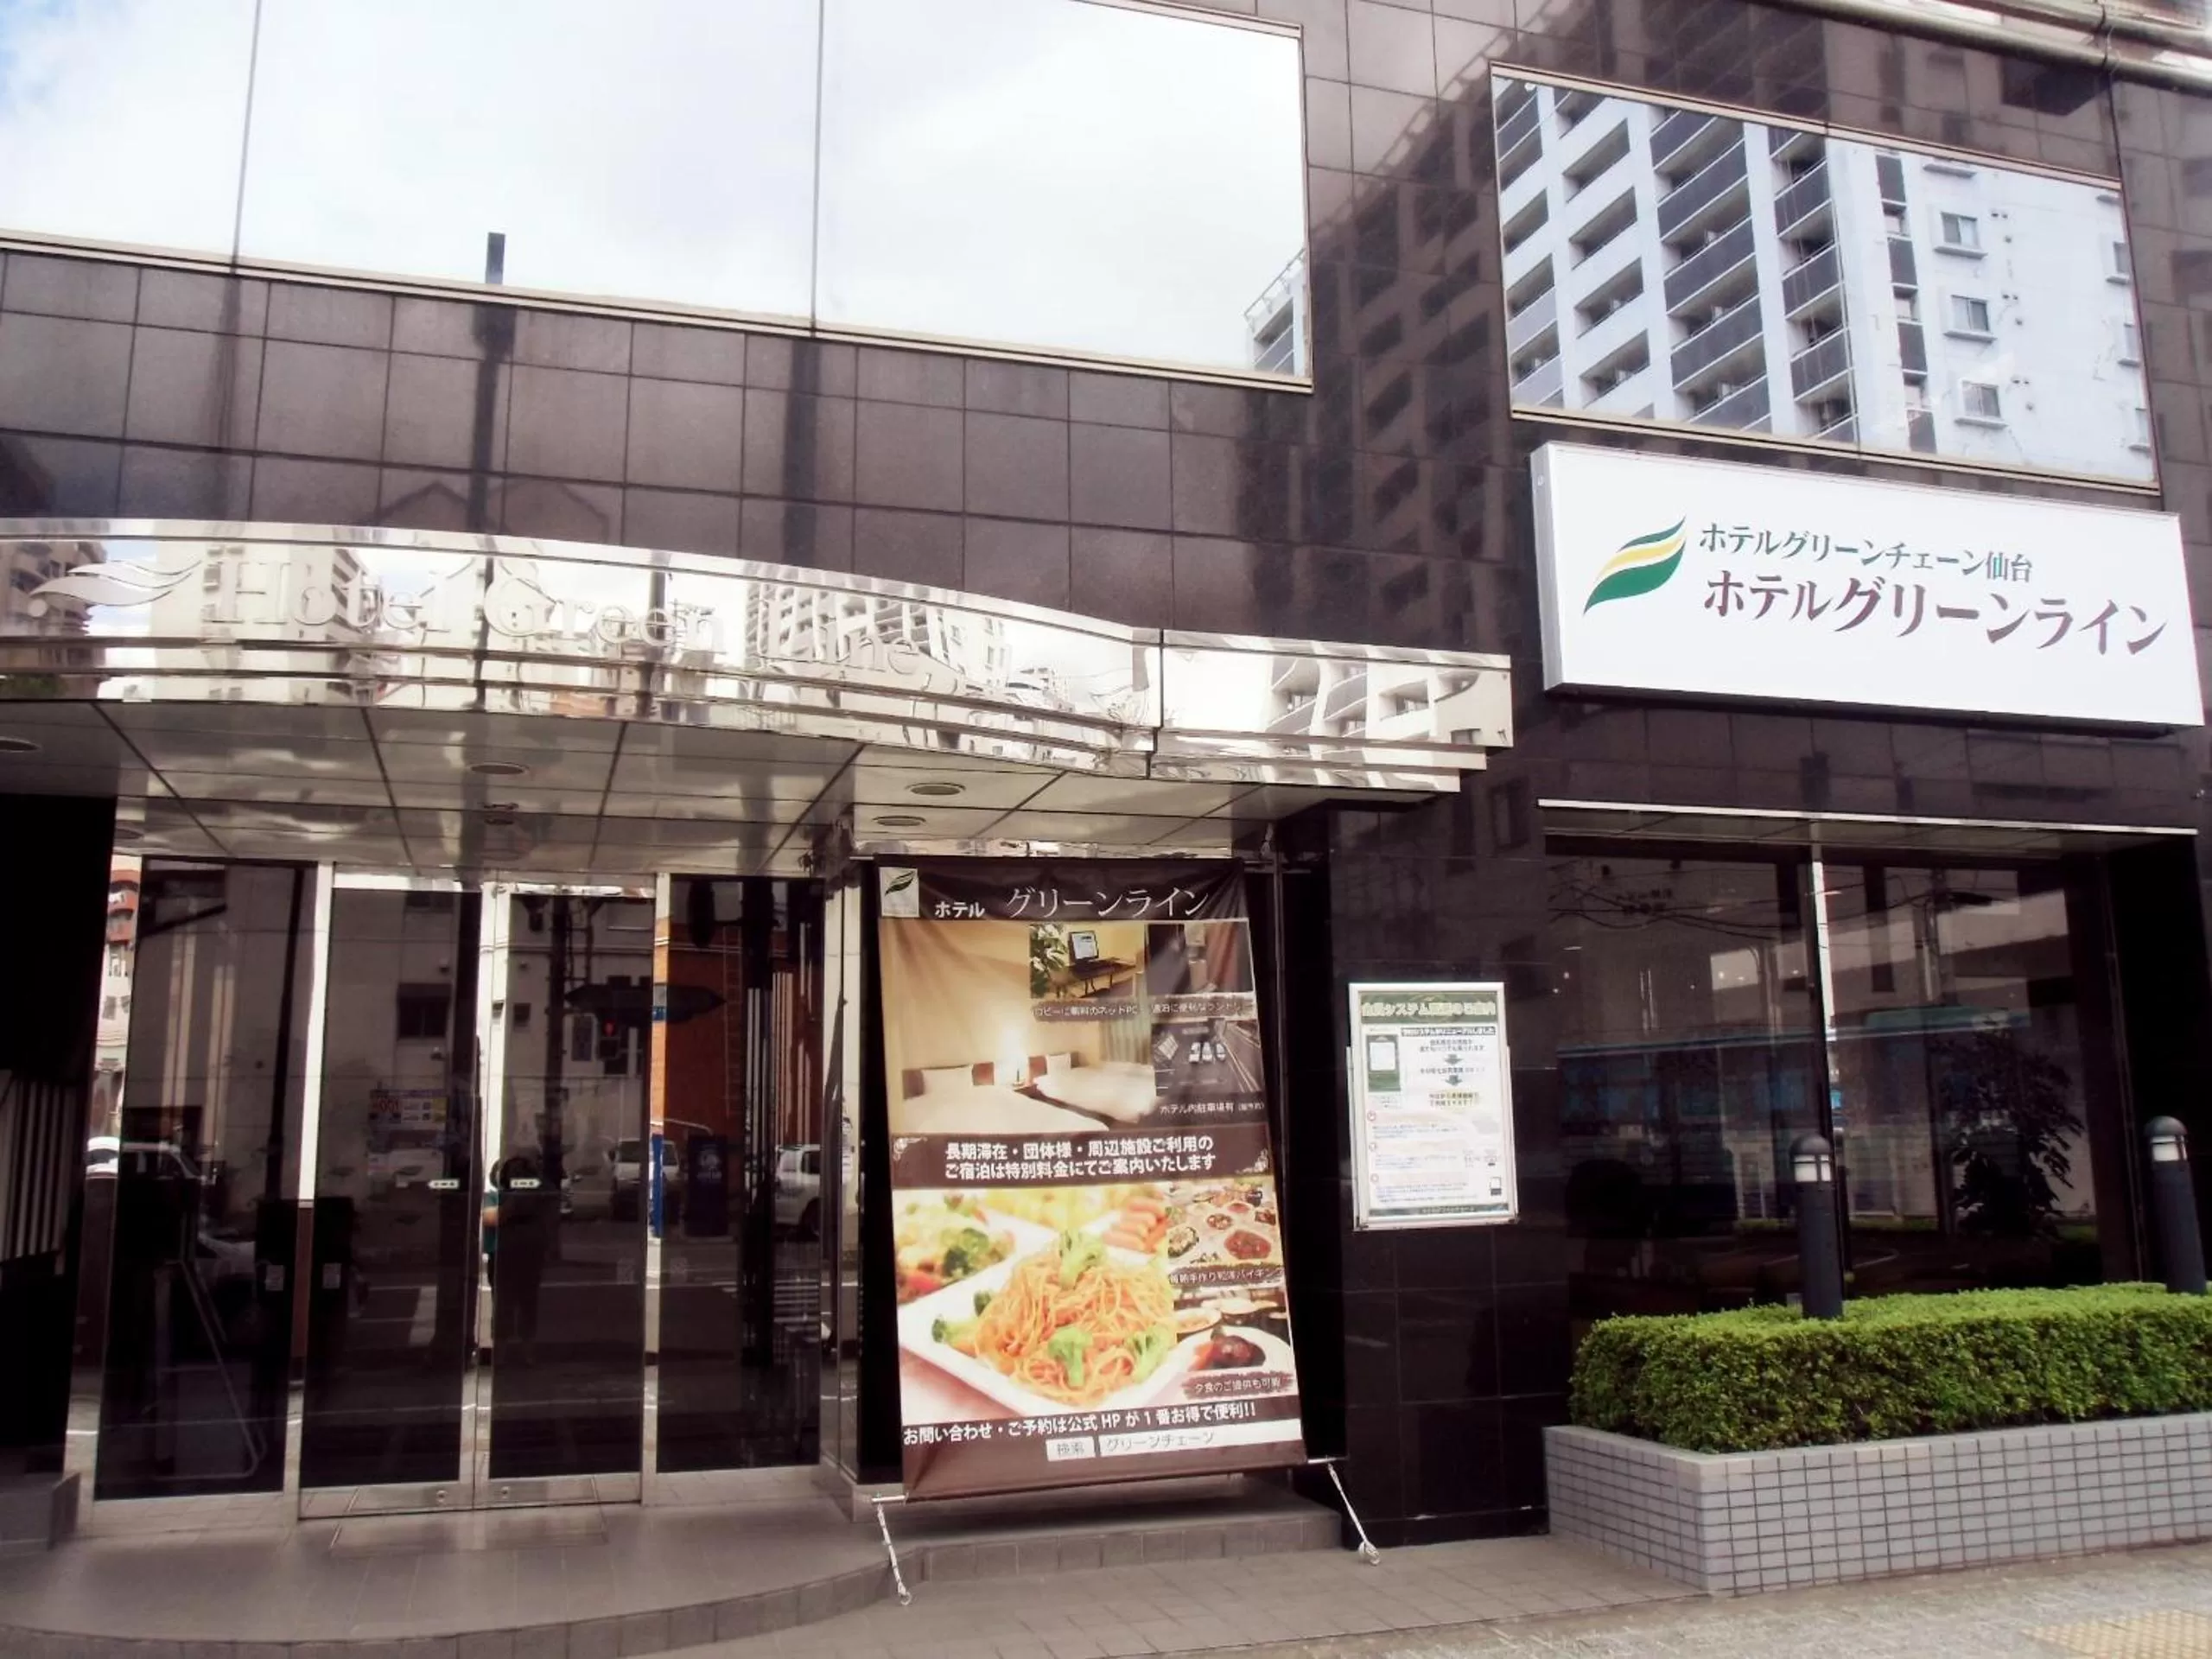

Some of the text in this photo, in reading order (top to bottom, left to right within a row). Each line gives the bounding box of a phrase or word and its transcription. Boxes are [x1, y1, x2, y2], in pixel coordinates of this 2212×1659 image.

[1699, 522, 2033, 583] ホテルグリーンチェーン仙台
[200, 560, 451, 632] Hotel
[484, 576, 727, 655] Green
[1704, 569, 2168, 656] ホテルグリーンライン
[935, 886, 1211, 919] ホテル グリーンライン
[945, 1135, 1214, 1160] 長期滞在・団体様・周辺施設ご利用の
[945, 1154, 1216, 1180] ご宿泊は特別料金にてご案内いたします
